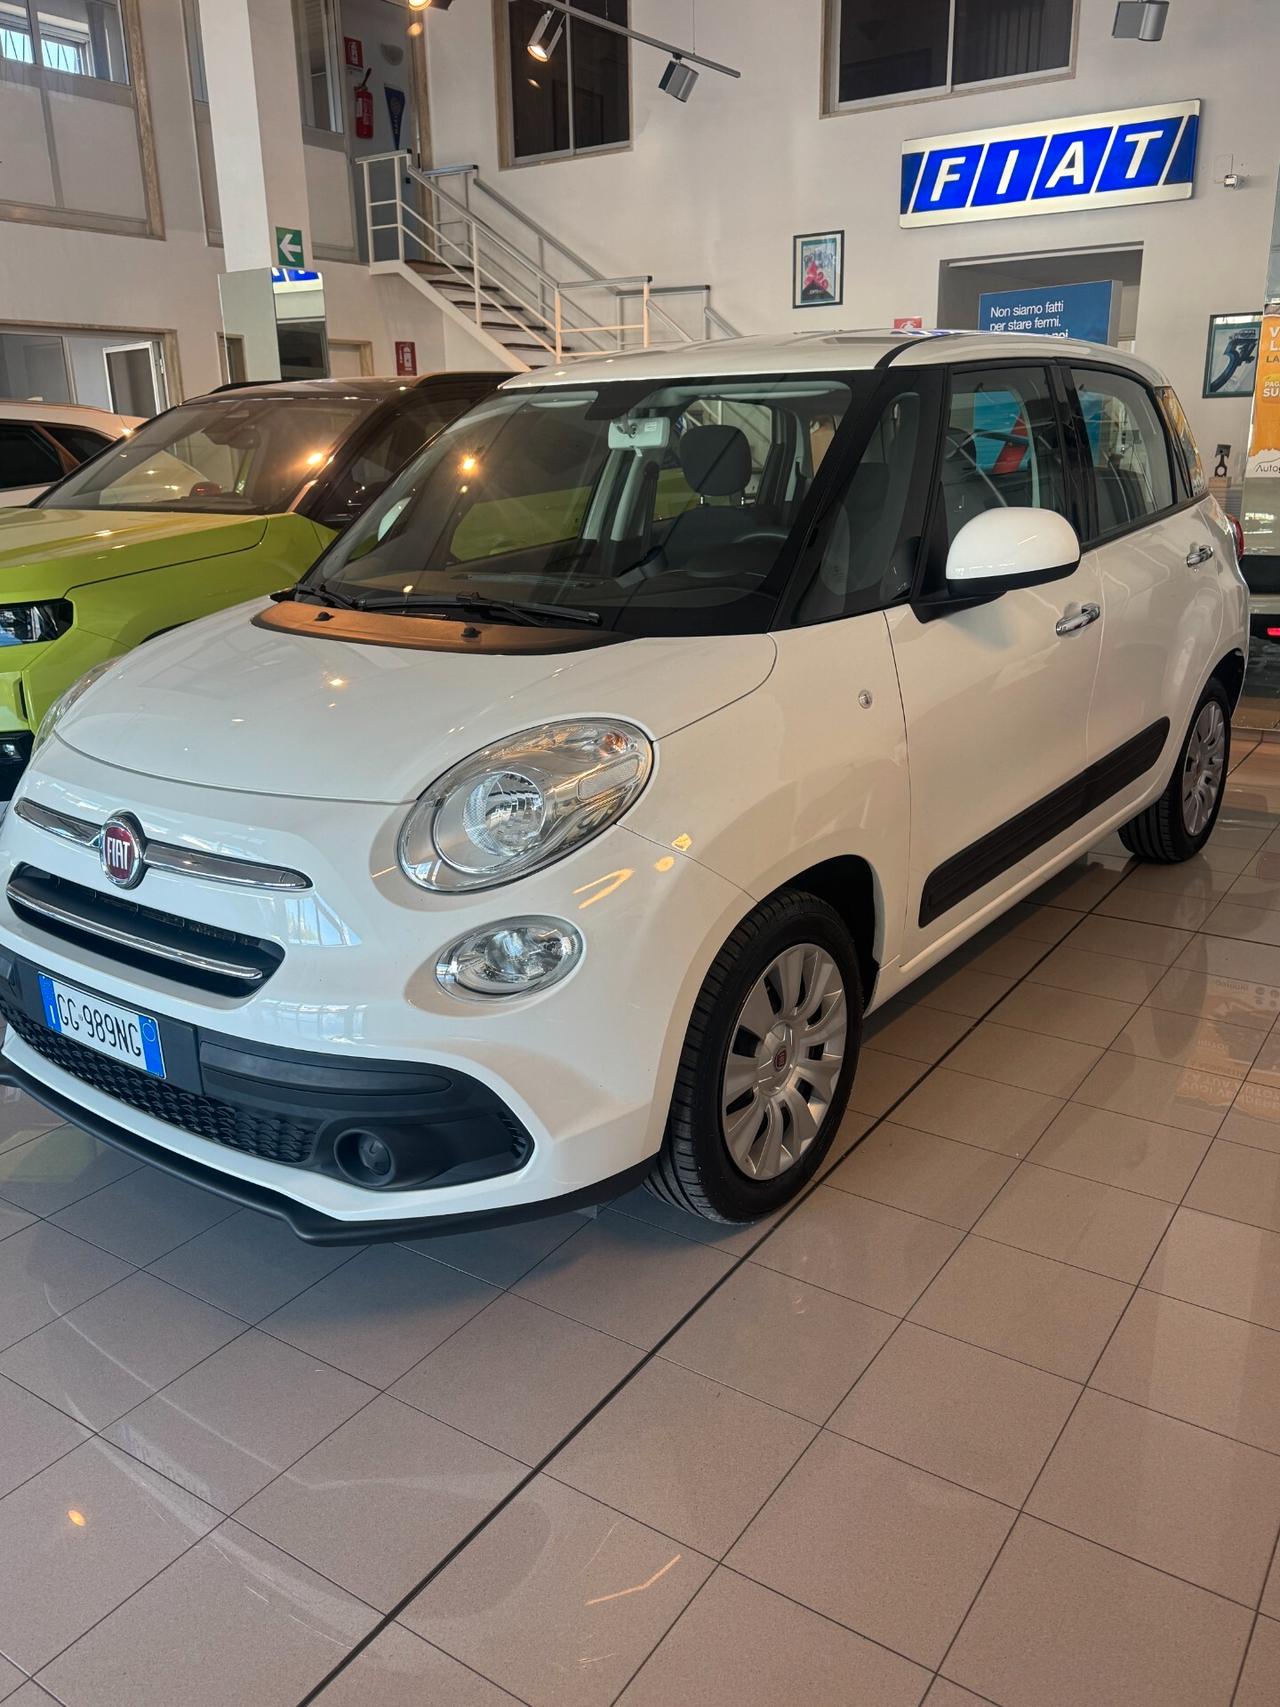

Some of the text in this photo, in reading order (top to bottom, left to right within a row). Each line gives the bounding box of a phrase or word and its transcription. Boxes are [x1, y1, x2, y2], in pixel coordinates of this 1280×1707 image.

[930, 130, 1164, 202] FIAT
[990, 300, 1064, 319] Non siamo fatti
[1008, 319, 1032, 331] stare
[1034, 315, 1062, 329] fermi.
[1263, 388, 1280, 397] SU
[106, 836, 131, 871] FIAT
